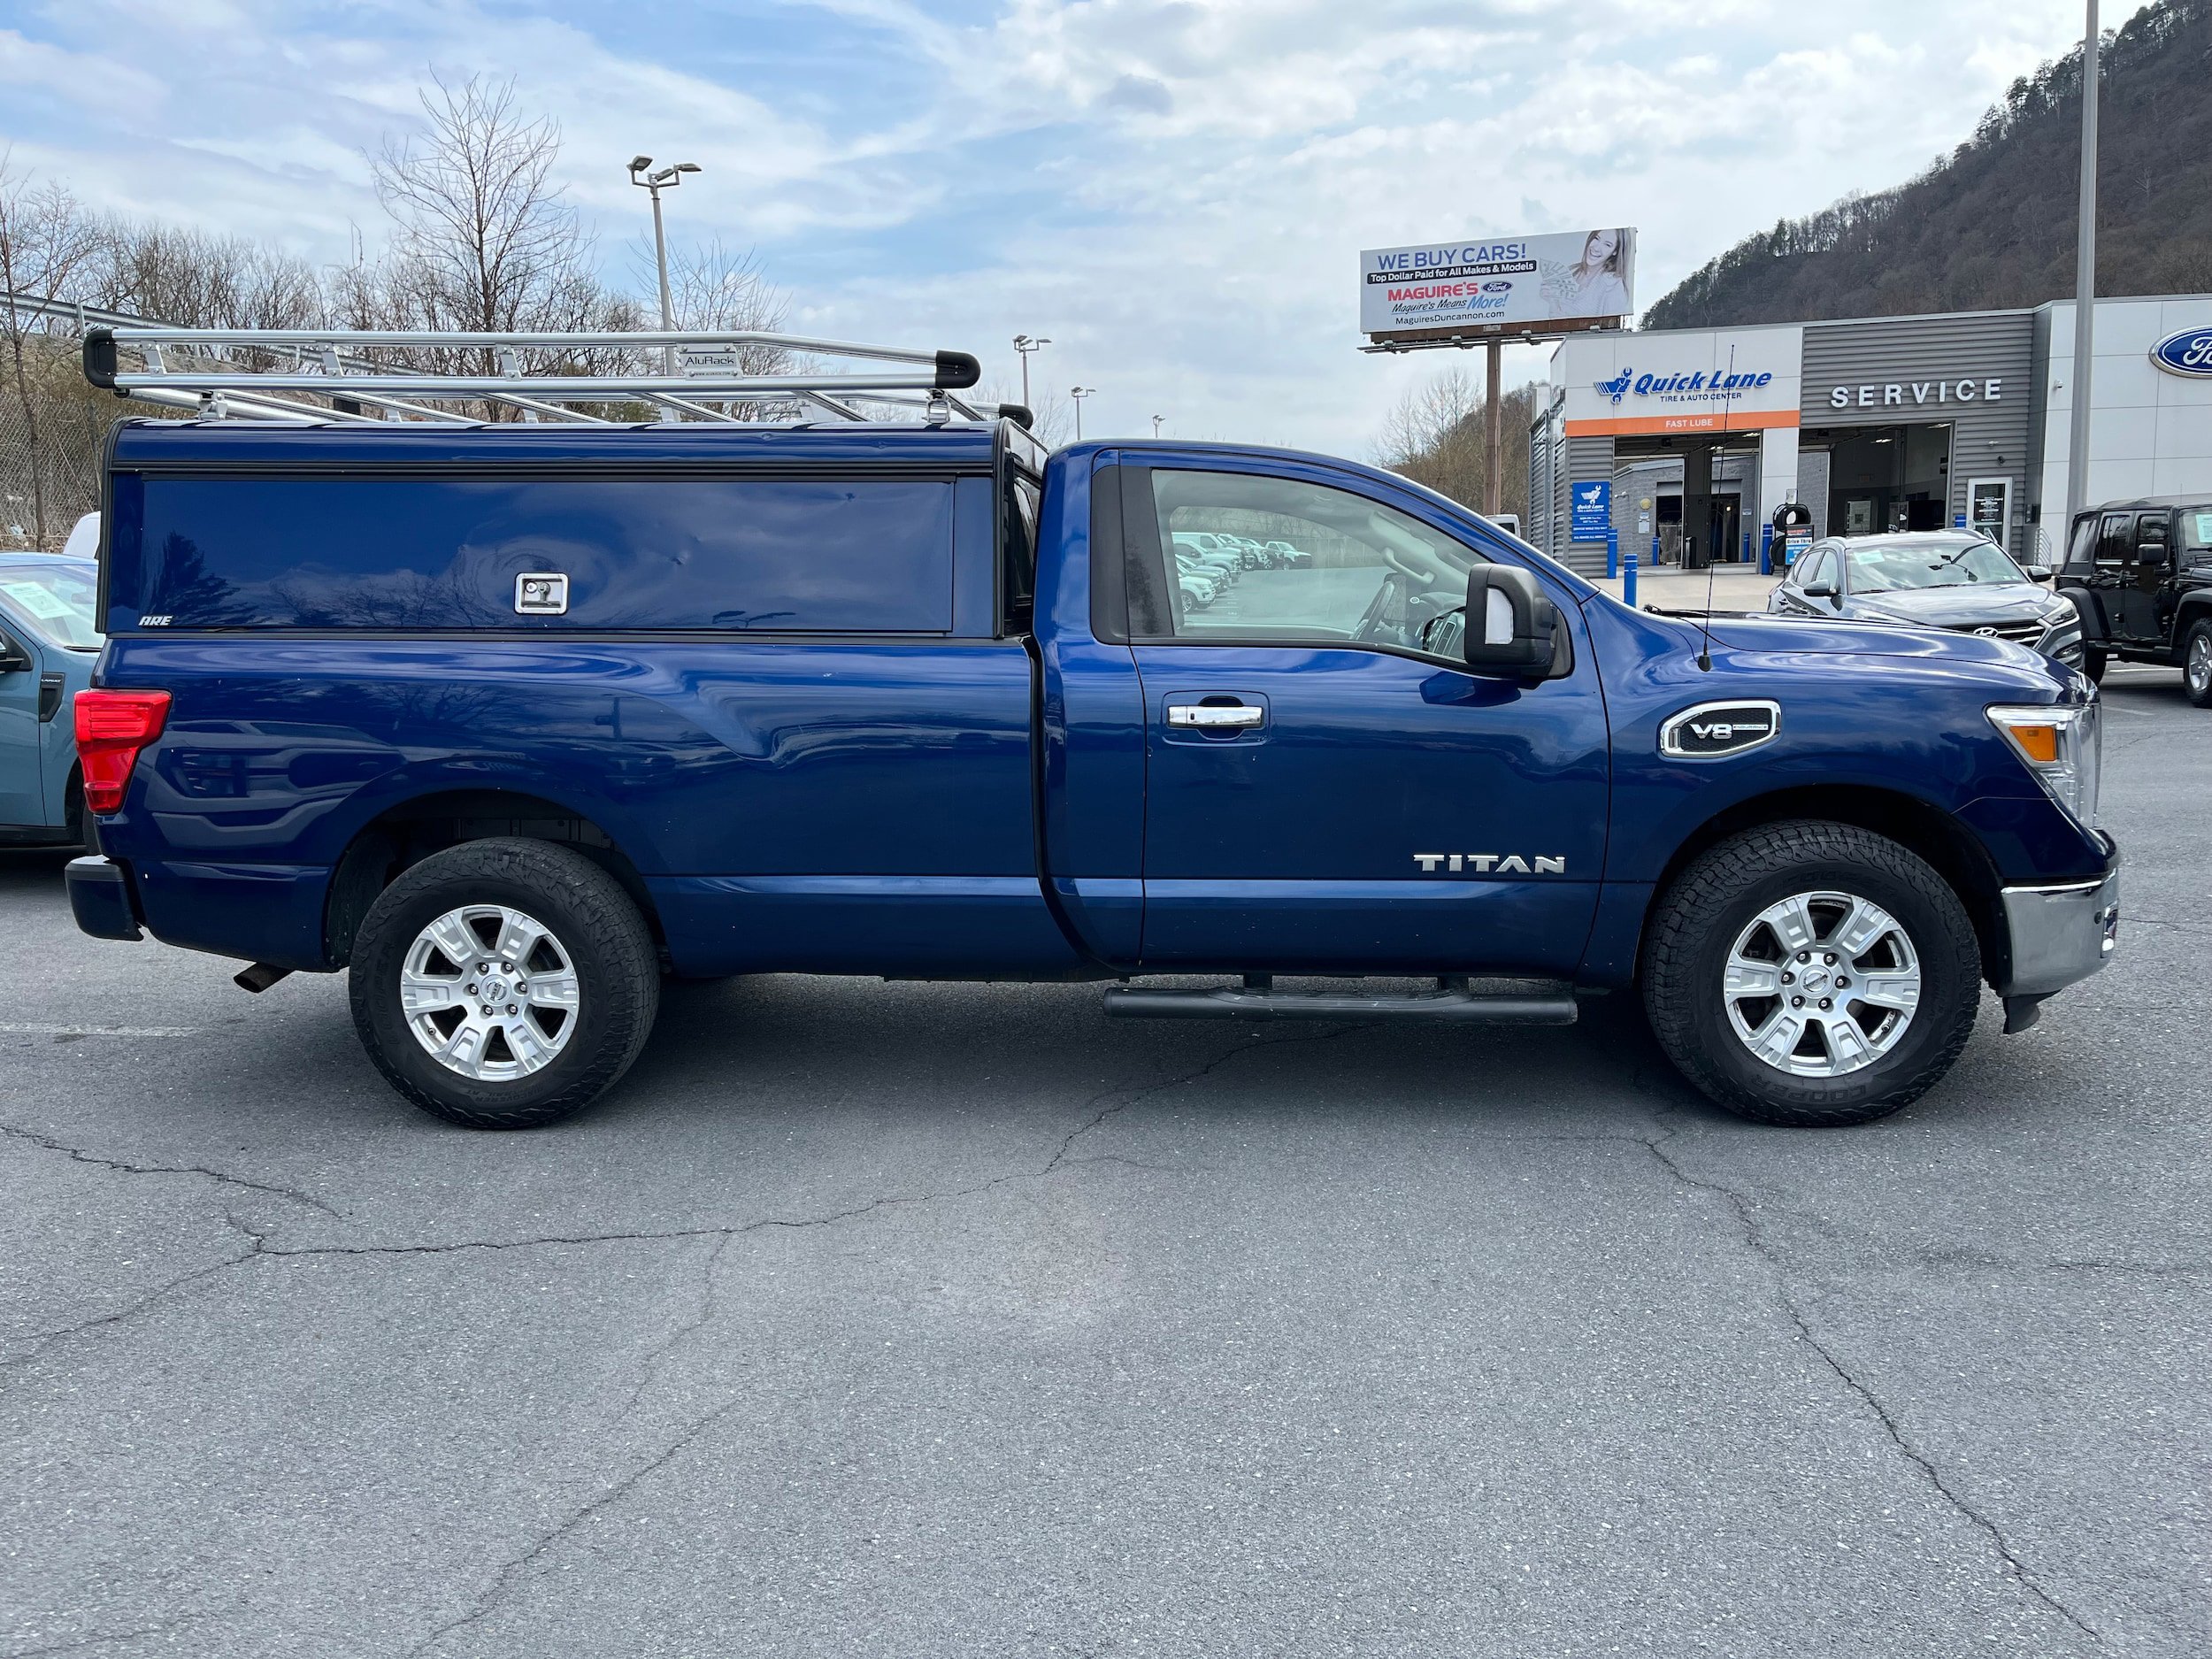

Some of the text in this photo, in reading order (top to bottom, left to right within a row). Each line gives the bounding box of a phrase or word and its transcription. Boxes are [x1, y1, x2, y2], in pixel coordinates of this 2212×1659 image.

[1378, 243, 1526, 270] WE BUY CARS!
[1371, 261, 1534, 283] Top Dollar Paid for All Makes & Models
[1387, 281, 1507, 302] MAGUIRE'S Ford
[1392, 293, 1509, 314] Maguire's Means More!
[1395, 310, 1505, 325] MaguiresDuncannon.com
[685, 356, 734, 367] AluRack
[1634, 370, 1772, 396] Quick Lane
[1831, 379, 2002, 409] SERVICE
[1665, 419, 1687, 428] FAST
[138, 615, 173, 626] ARE
[1689, 724, 1732, 739] V8
[1413, 855, 1565, 873] TITAN
